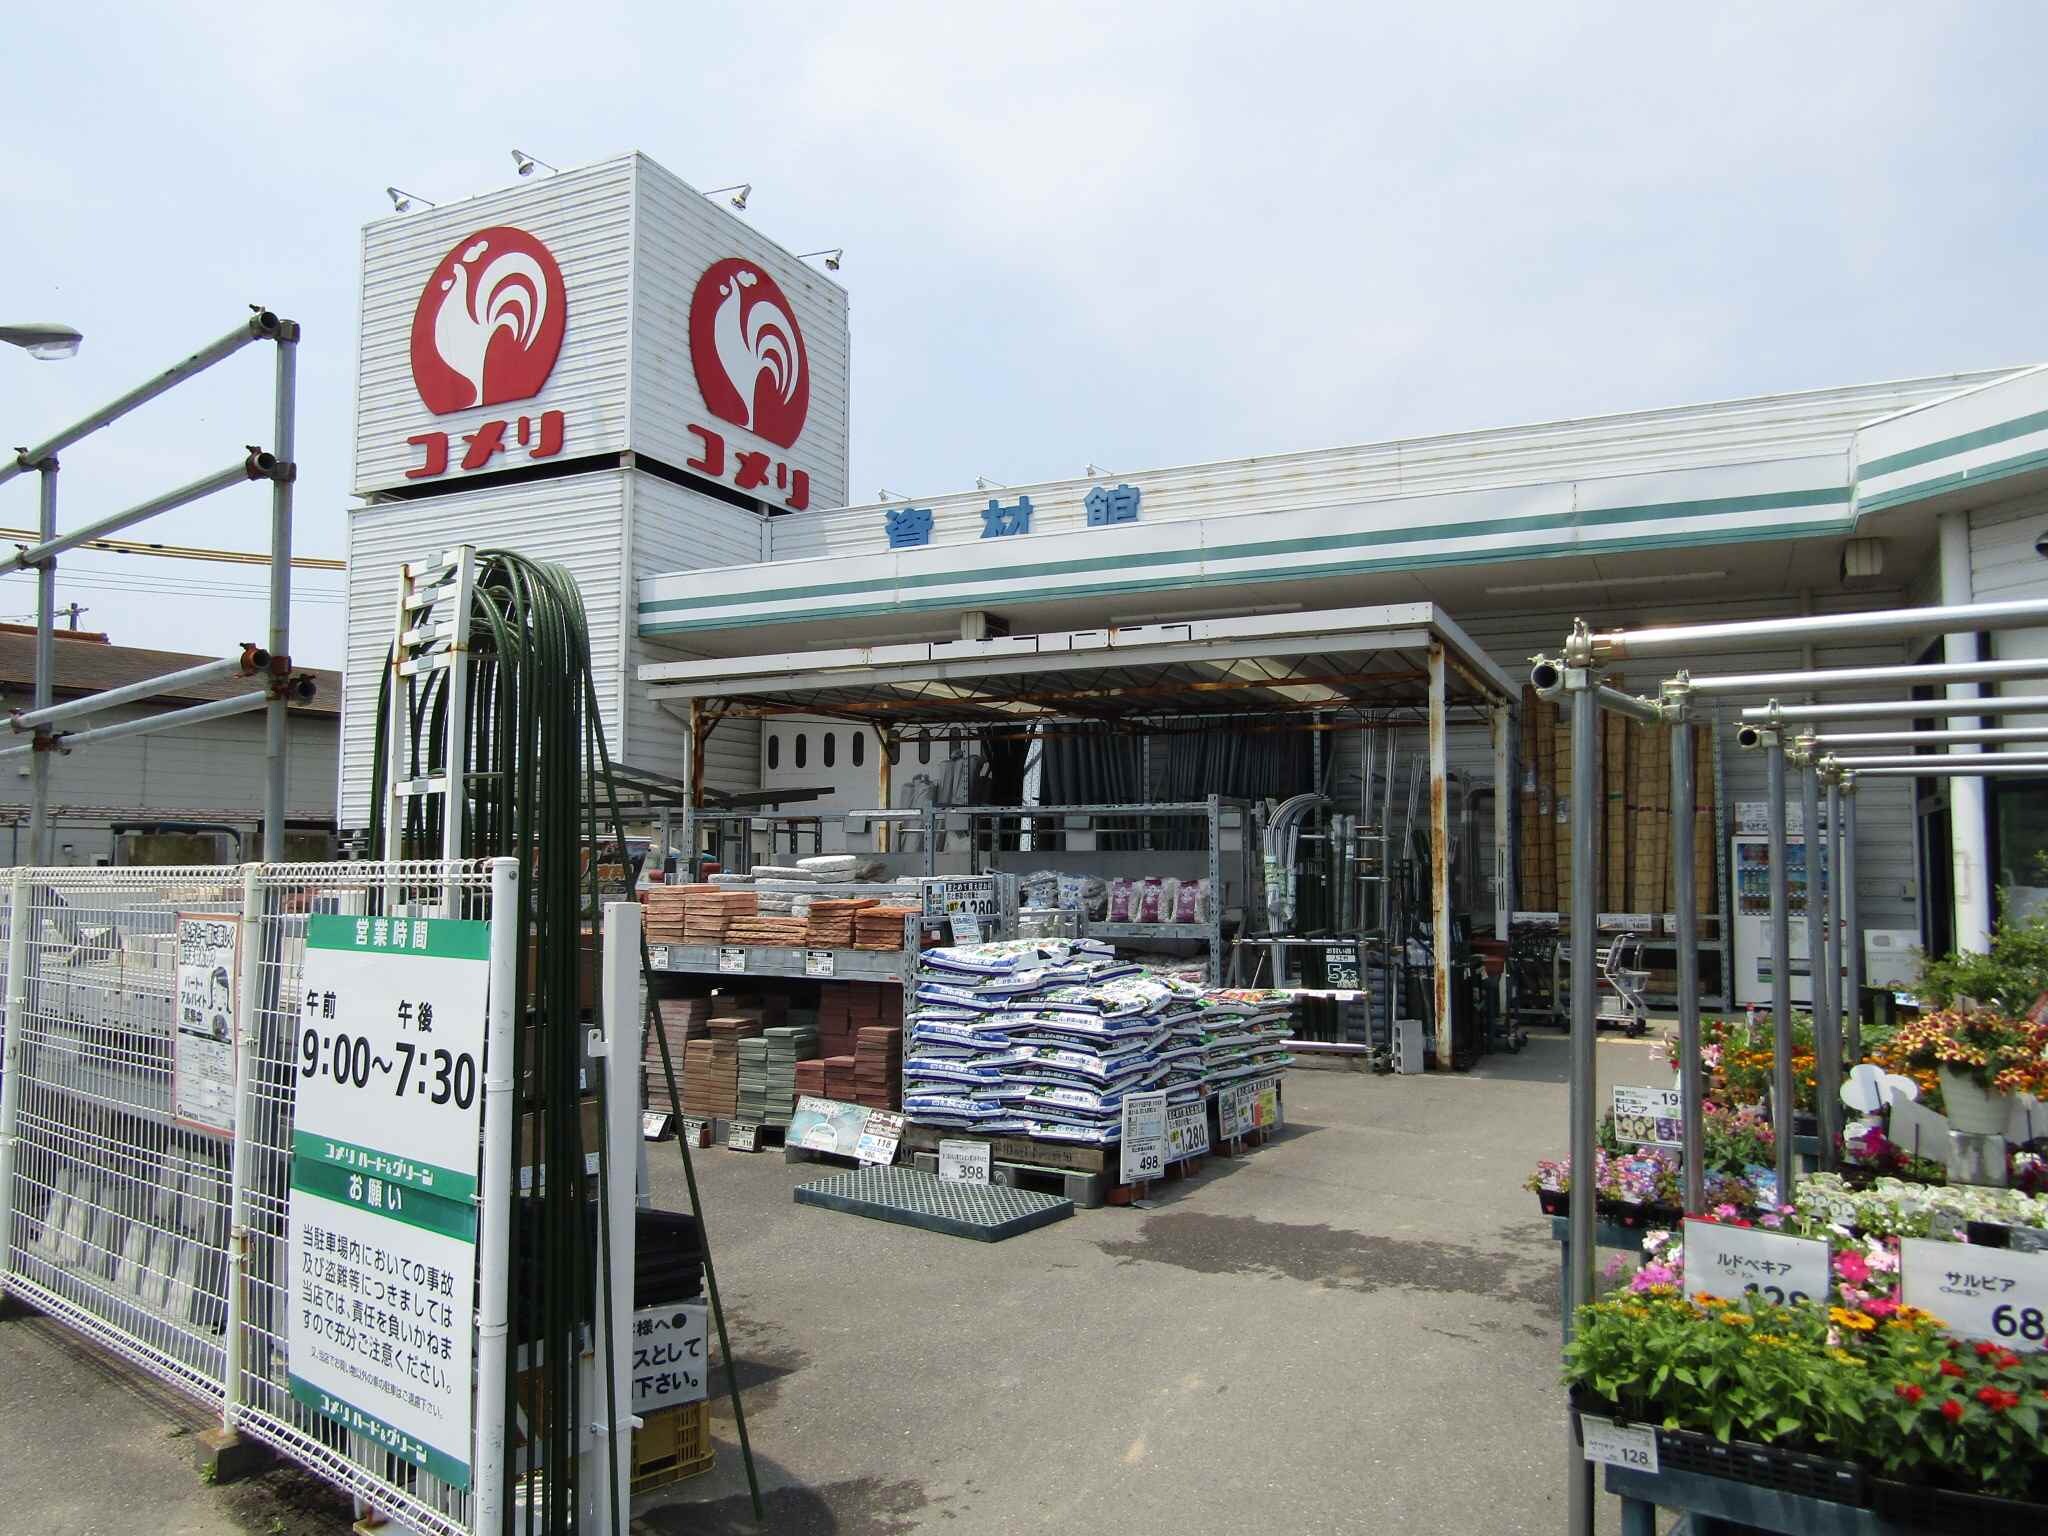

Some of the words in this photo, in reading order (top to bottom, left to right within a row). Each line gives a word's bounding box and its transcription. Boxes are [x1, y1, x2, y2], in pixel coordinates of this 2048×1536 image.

[405, 410, 565, 479] コメリ
[687, 424, 810, 511] コメリ
[356, 918, 429, 950] 営業時間
[306, 989, 337, 1020] 午前
[397, 1000, 434, 1033] 午後
[1616, 1103, 1648, 1114] トレニア
[1662, 1092, 1682, 1106] 19
[325, 1142, 355, 1164] コメリ
[1180, 1124, 1204, 1153] 1,280
[958, 1164, 984, 1180] 398
[1139, 1156, 1159, 1171] 498
[349, 1173, 403, 1211] お願い
[303, 1223, 455, 1299] 当駐車場内においての事故
[1716, 1252, 1793, 1277] ルドベキア
[302, 1251, 453, 1329] 及び盗難等につきましては
[1945, 1270, 2018, 1294] サルビア
[301, 1278, 453, 1361] 当店では、責任を負いかねま
[633, 1318, 671, 1337] 様へ
[1991, 1304, 2046, 1342] 68
[302, 1309, 453, 1395] すので充分ご注意ください。
[320, 1393, 351, 1422] コメリ
[1621, 1448, 1649, 1465] 128
